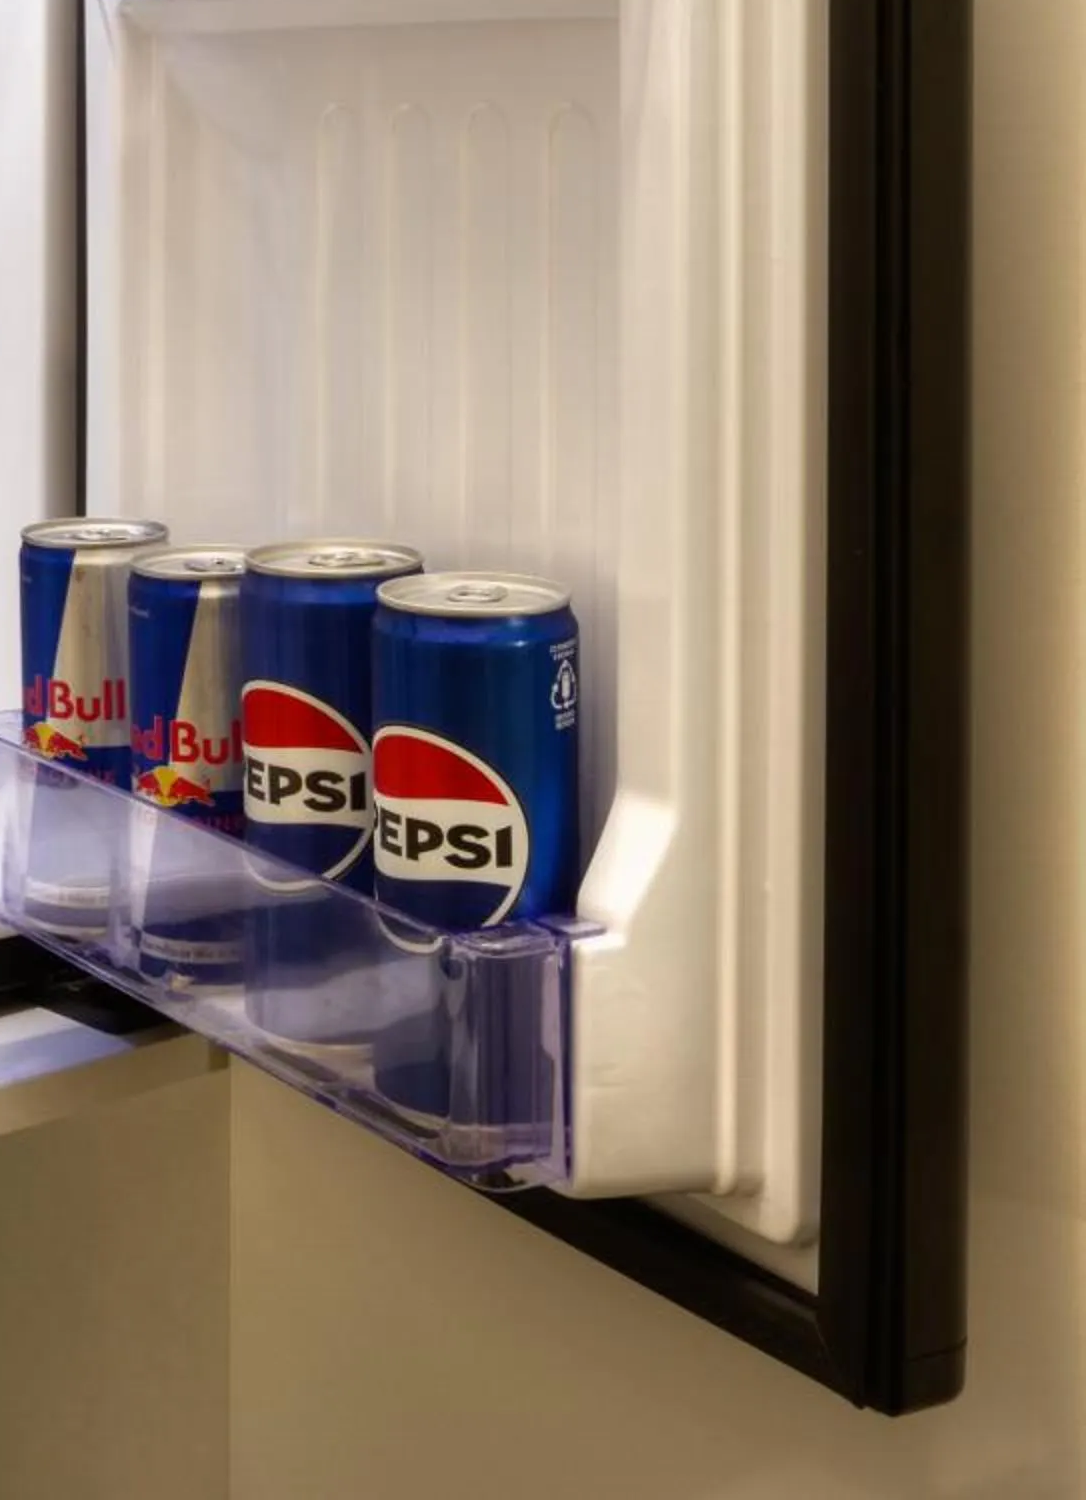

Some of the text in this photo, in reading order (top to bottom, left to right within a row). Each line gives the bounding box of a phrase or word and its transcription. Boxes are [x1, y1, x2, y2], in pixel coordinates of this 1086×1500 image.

[48, 677, 126, 722] Bull
[170, 718, 243, 766] Bul
[244, 758, 366, 813] EPSI
